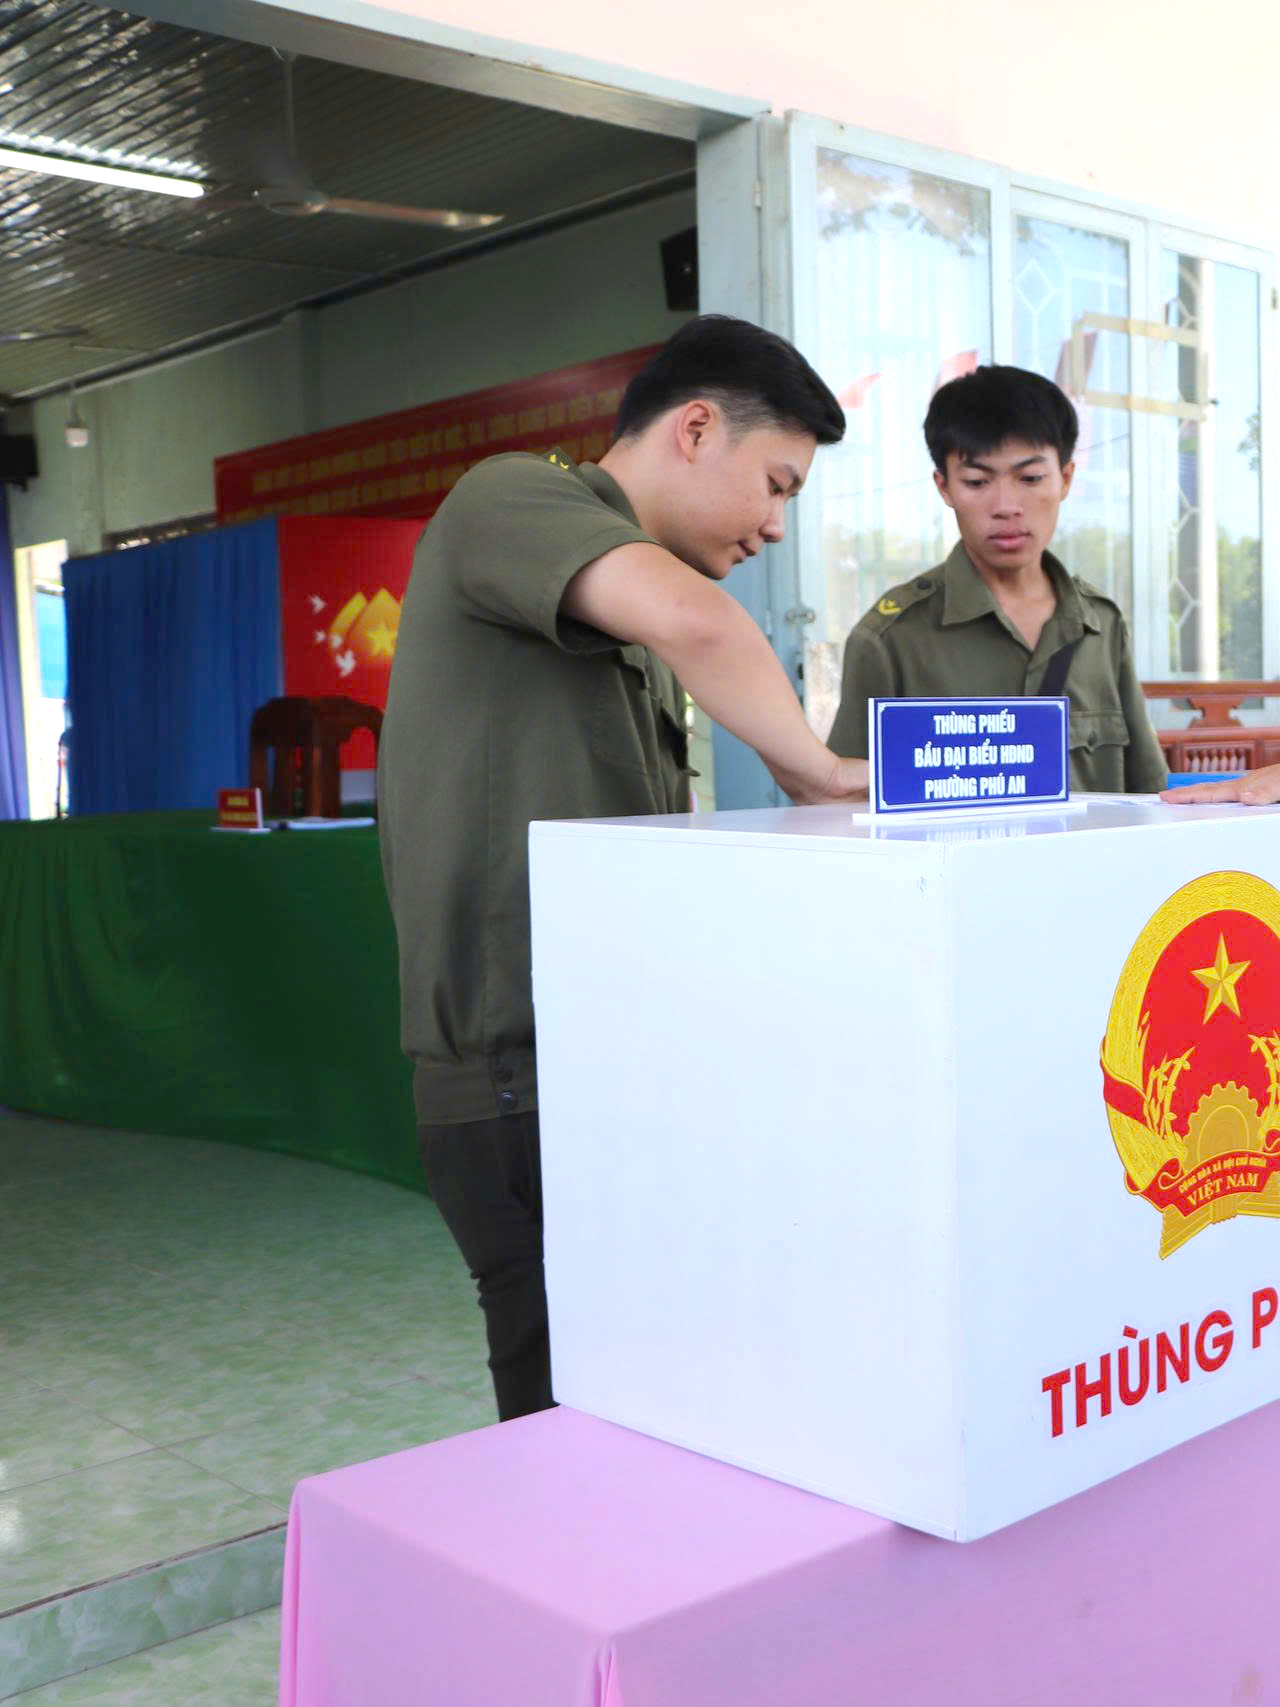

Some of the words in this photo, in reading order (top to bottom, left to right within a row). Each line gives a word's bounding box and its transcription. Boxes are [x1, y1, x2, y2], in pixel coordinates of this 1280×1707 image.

[933, 711, 977, 735] THÙNG
[978, 708, 1016, 734] PHIẾU
[914, 740, 942, 768] BẦU
[943, 746, 966, 770] ĐẠI
[968, 738, 998, 766] BIỂU
[1001, 744, 1035, 764] HĐND
[924, 774, 978, 800] PHƯỜNG
[979, 772, 1005, 797] PHÚ
[1008, 775, 1026, 795] AN
[1187, 1178, 1223, 1206] VIỆT
[1226, 1173, 1259, 1190] NAM
[1042, 1310, 1234, 1438] THÙNG
